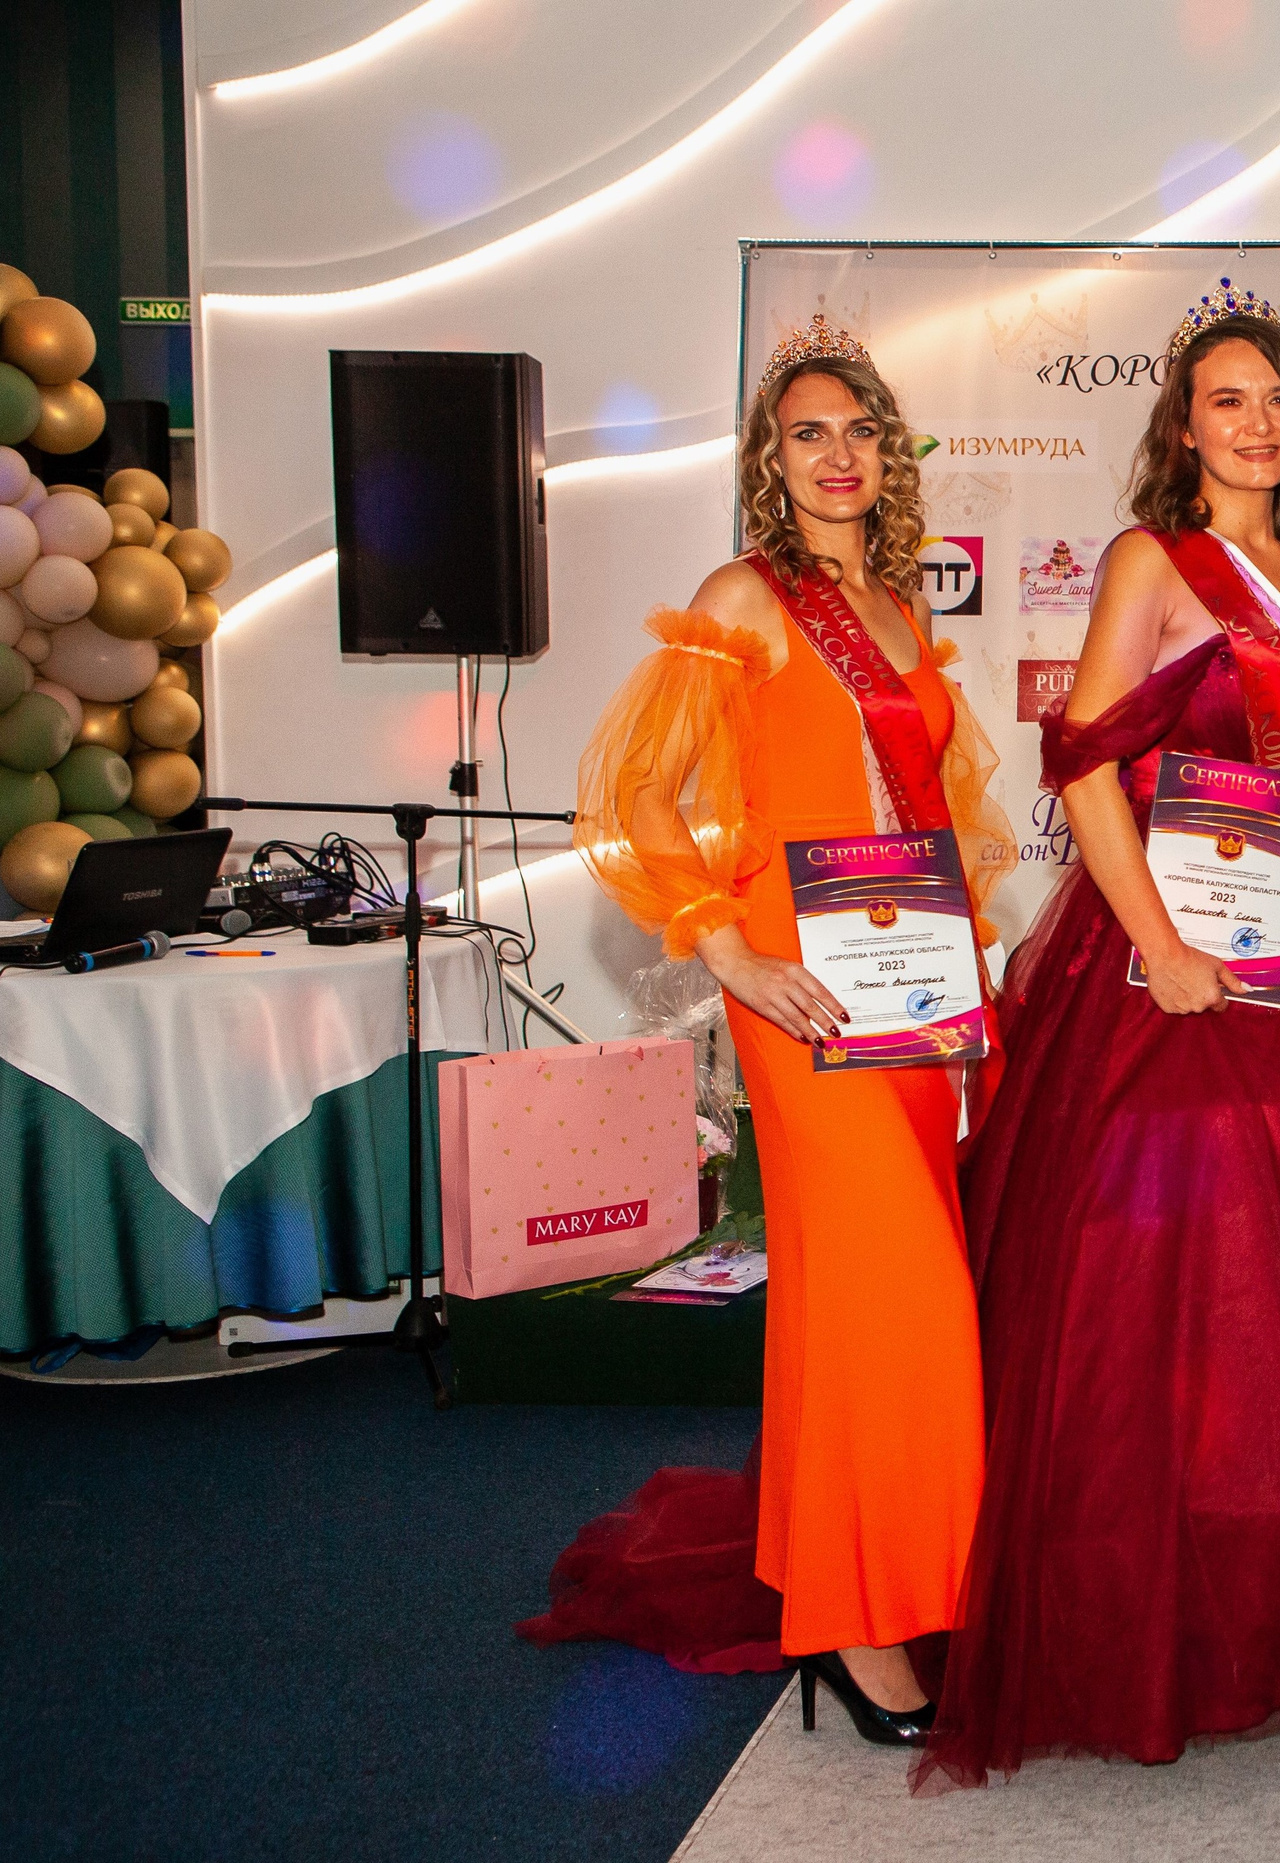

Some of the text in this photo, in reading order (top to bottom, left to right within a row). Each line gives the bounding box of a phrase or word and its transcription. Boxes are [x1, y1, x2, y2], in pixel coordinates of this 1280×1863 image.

[125, 303, 191, 320] ВЫХОД
[1036, 354, 1168, 394] «КОРО
[948, 436, 1087, 461] ИЗУМРУДА
[806, 837, 937, 867] CERTIFICATE
[1164, 874, 1205, 885] «КОРОЛЕВА
[1206, 880, 1249, 891] КАЛУЖСКОЙ
[1209, 891, 1236, 904] 2023
[824, 945, 955, 962] «КОРОЛЕВА КАЛУЖСКОЙ ОБЛАСТИ»
[877, 959, 906, 972] 2023
[535, 1204, 642, 1239] MARY KAY
